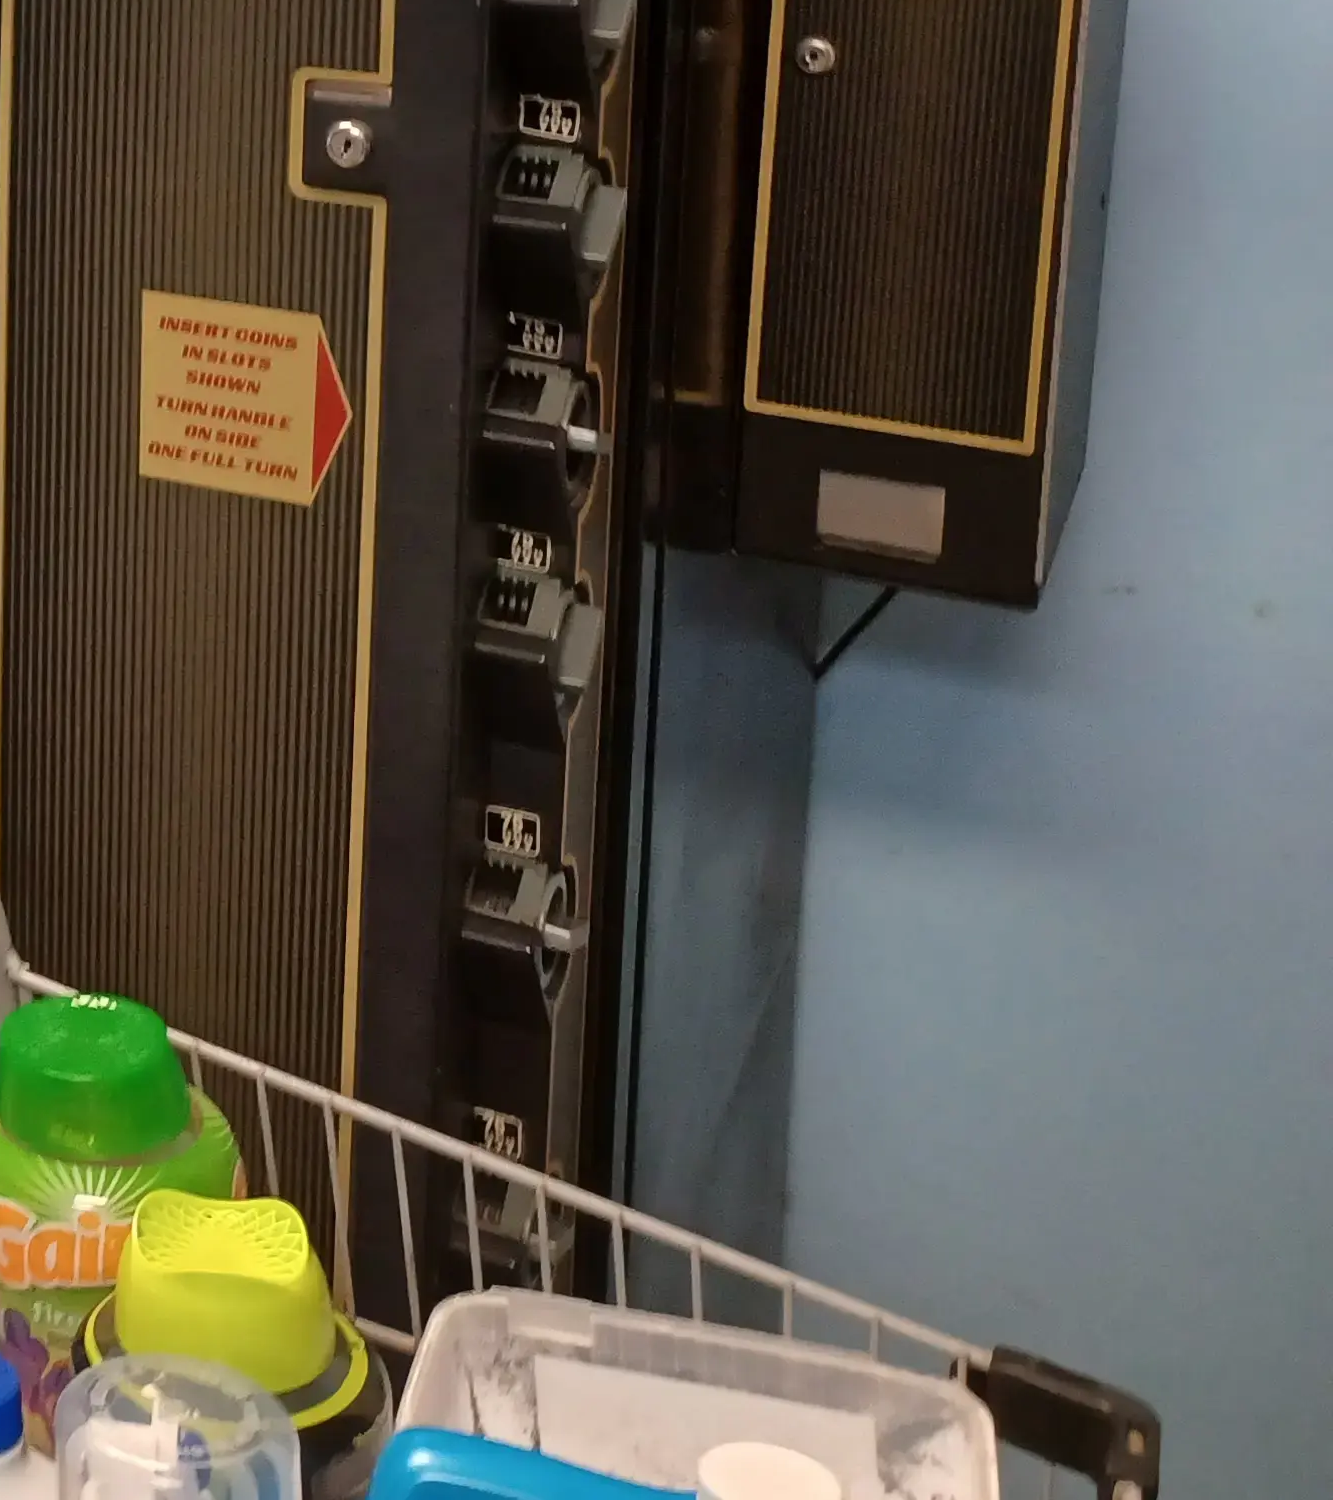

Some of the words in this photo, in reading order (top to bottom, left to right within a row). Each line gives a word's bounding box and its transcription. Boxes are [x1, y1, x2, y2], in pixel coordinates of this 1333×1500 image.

[159, 315, 230, 339] INSERT
[235, 327, 298, 350] COINS
[182, 344, 203, 362] IN
[207, 348, 272, 372] SLOTS
[186, 369, 262, 395] SHOWN
[156, 395, 208, 417] TURN
[211, 404, 293, 430] HANDLE
[184, 424, 213, 442] ON
[215, 428, 263, 449] SIDE
[148, 440, 187, 459] ONE
[190, 448, 242, 469] FULL
[244, 458, 298, 482] TURN
